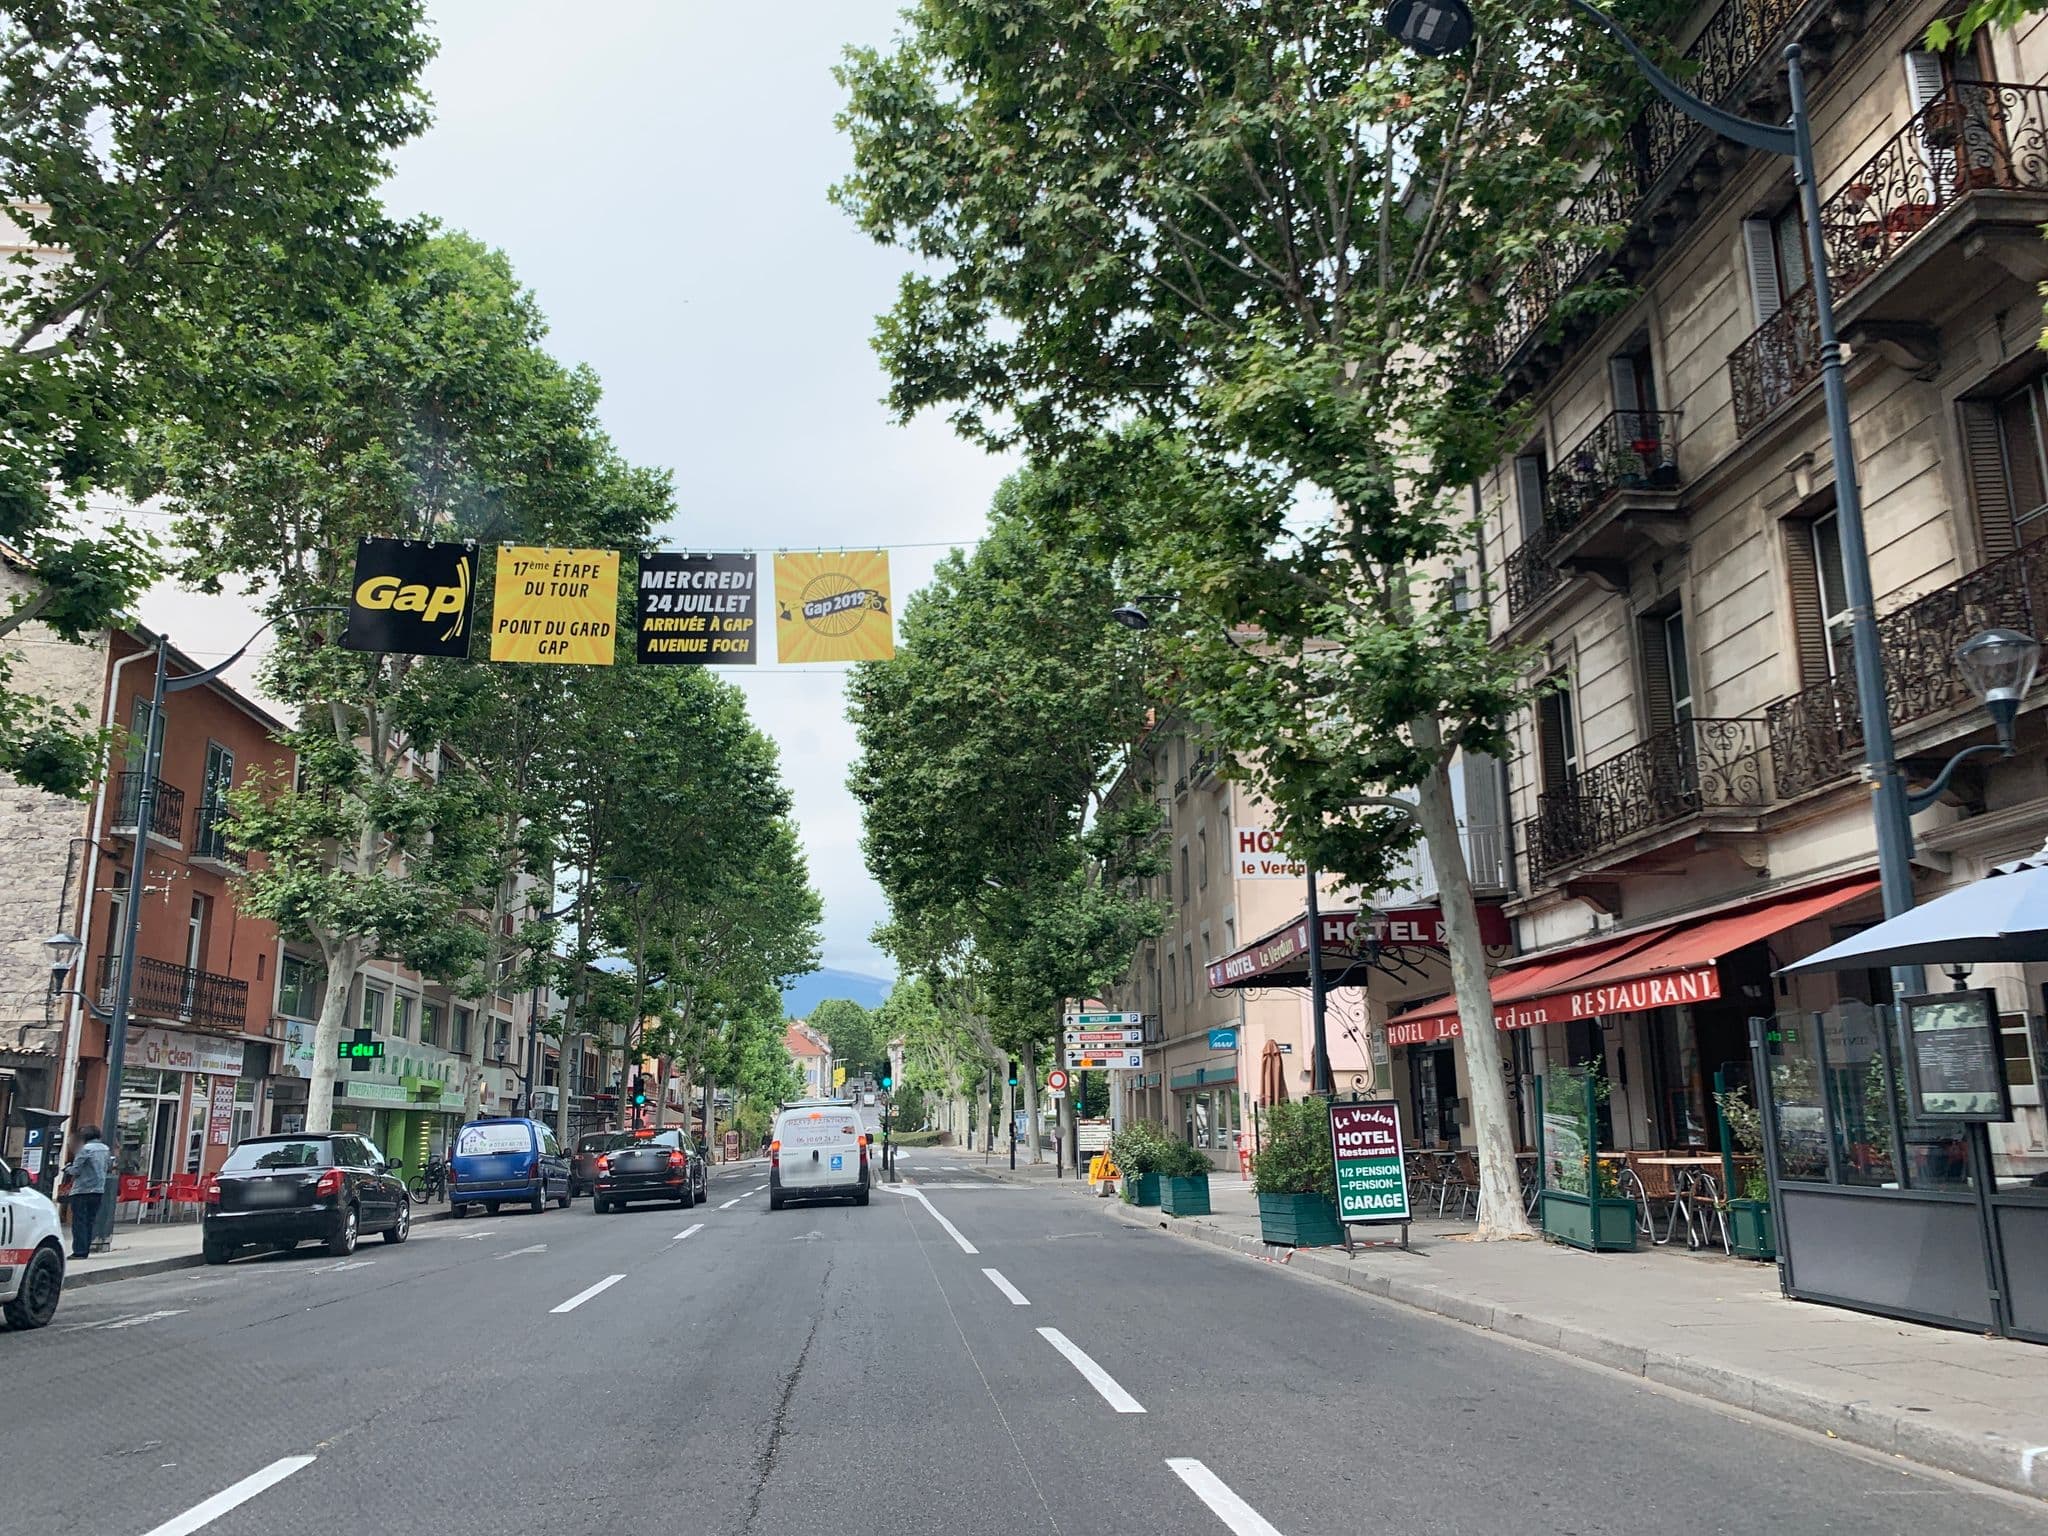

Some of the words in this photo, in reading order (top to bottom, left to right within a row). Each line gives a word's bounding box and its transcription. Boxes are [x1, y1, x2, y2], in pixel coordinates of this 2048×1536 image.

[513, 559, 550, 576] 17ème
[553, 560, 600, 579] ÉTAPE
[524, 581, 545, 596] DU
[550, 582, 589, 598] TOUR
[641, 571, 753, 590] MERCREDI
[355, 575, 463, 622] Gap
[646, 595, 671, 613] 24
[674, 595, 750, 613] JUILLET
[804, 599, 833, 618] Gap
[833, 590, 865, 612] 2019
[499, 619, 539, 635] PONT
[545, 621, 566, 636] DU
[570, 622, 610, 637] GARD
[643, 614, 705, 632] ARRIVÉE
[709, 614, 721, 632] À
[723, 619, 753, 632] GAP
[538, 640, 569, 655] GAP
[647, 639, 708, 653] AVENUE
[712, 638, 749, 653] FOCH
[1242, 861, 1256, 874] le
[1225, 955, 1256, 979] HOTEL
[1259, 951, 1270, 968] Le
[1269, 939, 1294, 964] Verdun
[1388, 1023, 1424, 1043] HOTEL
[1439, 1019, 1459, 1038] Le
[1572, 970, 1712, 1017] RESTAURANT
[1335, 1116, 1350, 1129] Le
[1351, 1109, 1393, 1126] Verdun
[1338, 1131, 1394, 1146] HOTEL
[1339, 1146, 1396, 1157] Restaurant
[1340, 1167, 1354, 1178] 1/2
[1356, 1165, 1400, 1177] PENSION
[1343, 1193, 1403, 1210] GARAGE
